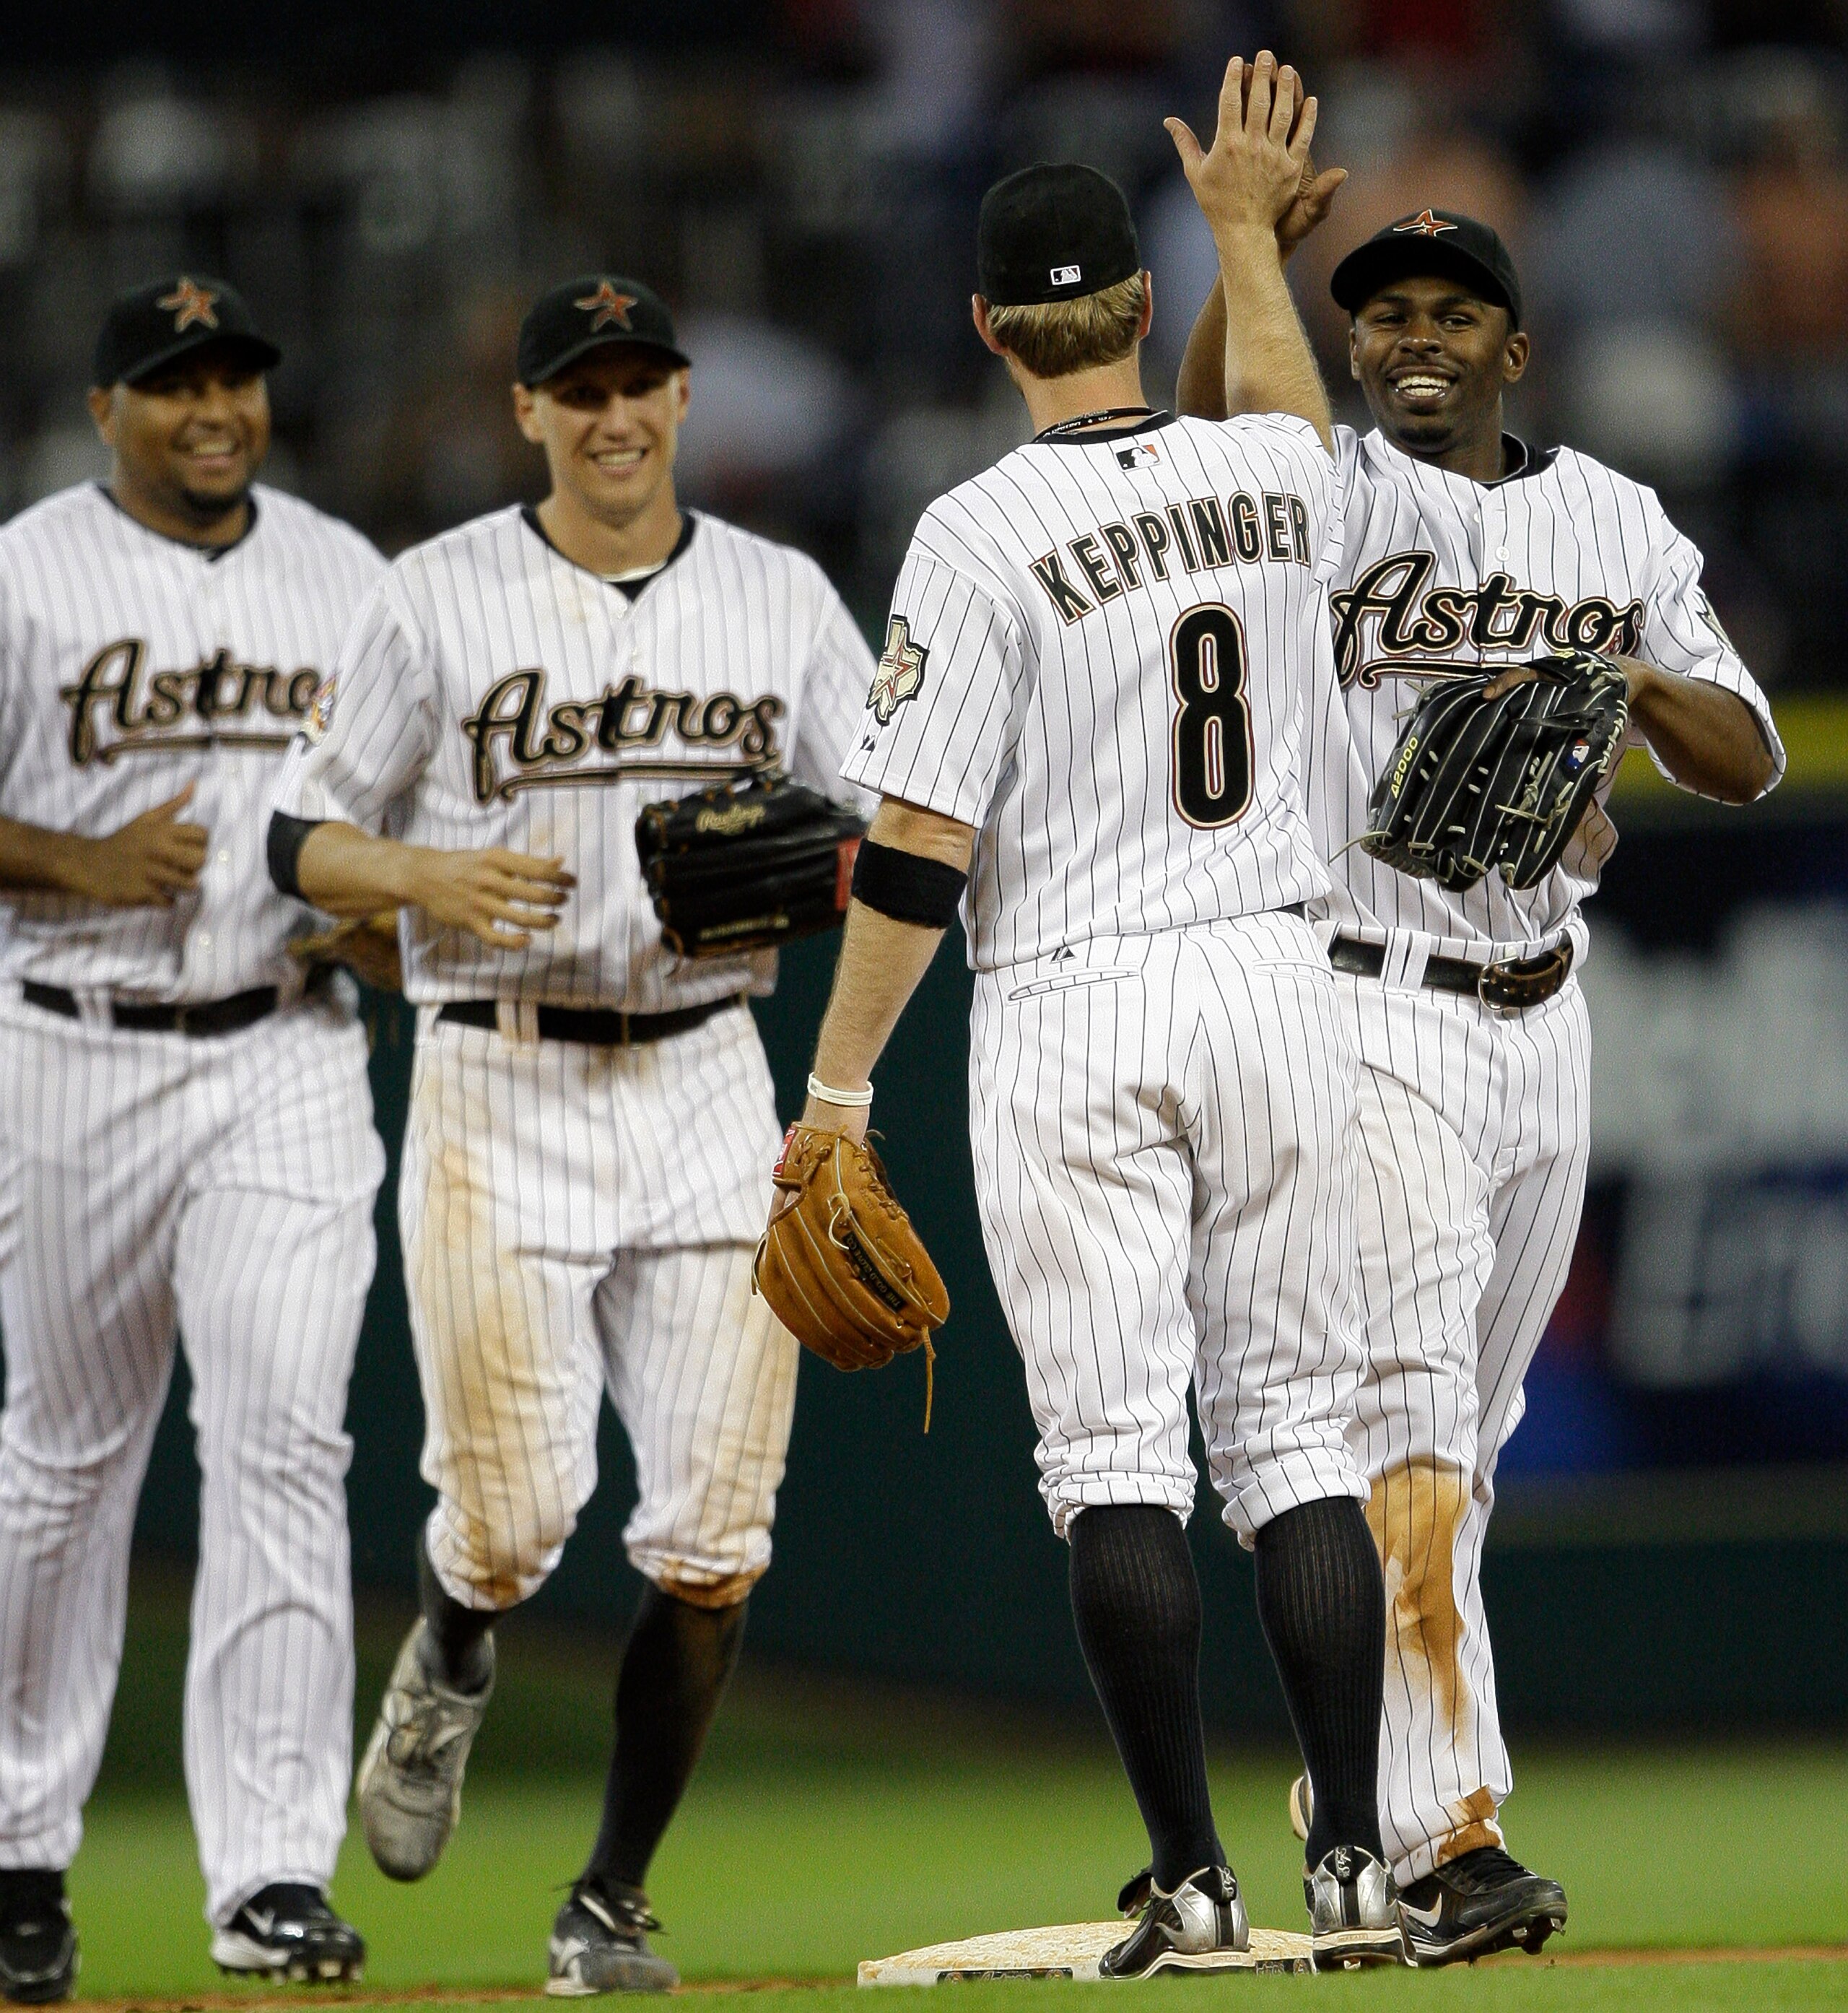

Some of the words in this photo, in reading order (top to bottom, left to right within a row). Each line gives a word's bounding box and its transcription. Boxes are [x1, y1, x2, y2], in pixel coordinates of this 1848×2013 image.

[1029, 490, 1311, 626] KEPPINGER
[58, 638, 321, 768] Astro
[461, 669, 785, 807] Astros
[1169, 601, 1255, 830] 8
[1391, 737, 1418, 799] A2000
